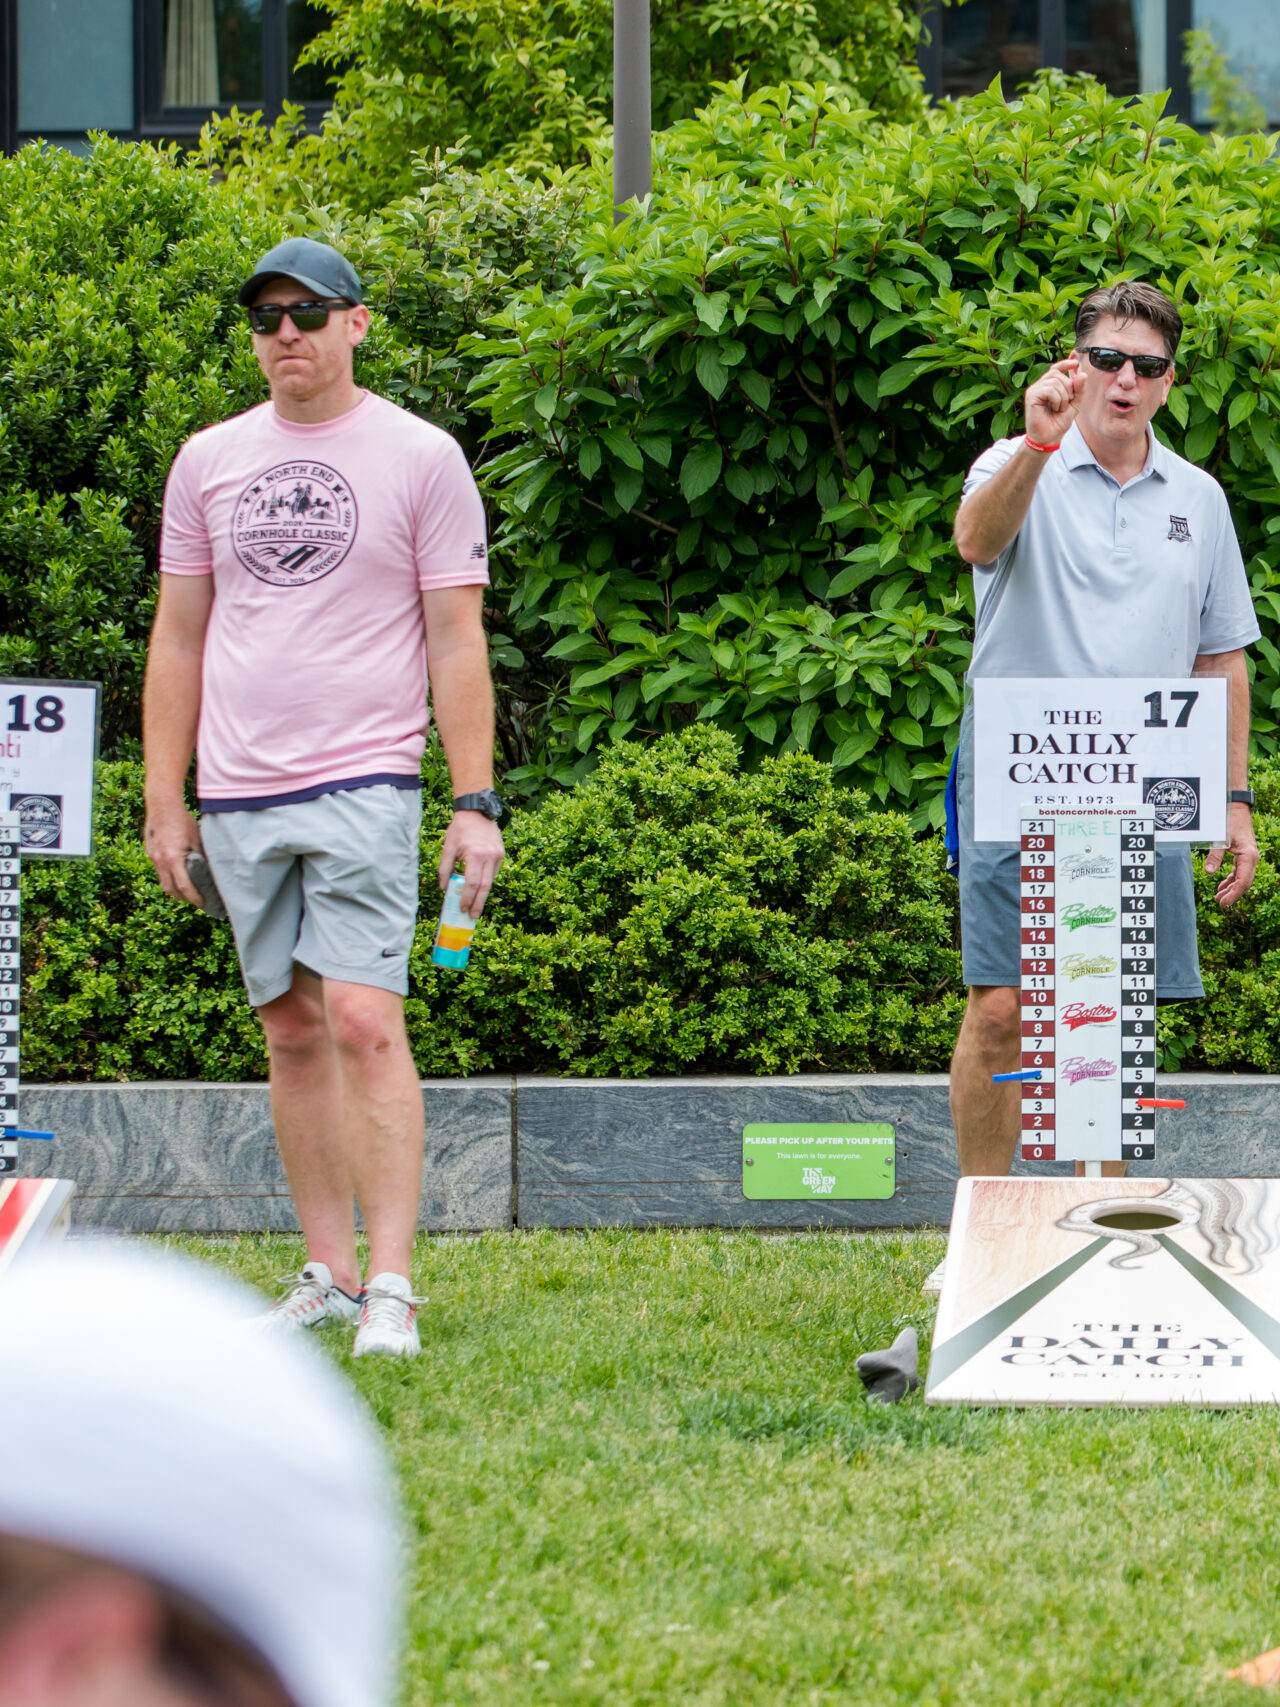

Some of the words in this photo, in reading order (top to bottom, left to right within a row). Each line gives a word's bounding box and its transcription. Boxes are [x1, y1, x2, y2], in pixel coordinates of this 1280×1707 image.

[265, 465, 309, 483] NORTH
[310, 466, 335, 482] END
[237, 528, 298, 543] CORNHOLE
[302, 528, 349, 543] CLASSIC
[7, 694, 65, 734] 18
[1143, 691, 1199, 728] 17
[1044, 710, 1102, 725] THE
[1008, 733, 1139, 755] DAILY
[1008, 762, 1139, 785] CATCH
[1034, 796, 1072, 804] EST.
[1078, 796, 1114, 804] 1973
[1039, 808, 1137, 816] bostoncornhole.com
[1028, 822, 1044, 832] 21
[1057, 820, 1117, 837] THREE
[1129, 822, 1144, 832] 21
[1028, 838, 1045, 848] 20
[1128, 838, 1146, 848] 20
[1030, 854, 1046, 863] 19
[1130, 854, 1146, 863] 19
[1028, 869, 1045, 879] 18
[1129, 869, 1146, 879] 18
[1030, 885, 1046, 894] 17
[1130, 885, 1146, 894] 17
[1028, 900, 1045, 910] 16
[1129, 900, 1146, 910] 16
[1030, 916, 1047, 925] 15
[1131, 916, 1147, 925] 15
[1029, 931, 1047, 941] 14
[1130, 931, 1147, 941] 14
[1030, 947, 1047, 956] 13
[1131, 947, 1147, 956] 13
[1030, 961, 1047, 972] 12
[1131, 961, 1147, 972] 12
[1030, 978, 1045, 987] 11
[1131, 978, 1146, 987] 11
[1030, 992, 1047, 1002] 10
[1131, 992, 1147, 1002] 10
[1034, 1008, 1042, 1018] 9
[1135, 1008, 1143, 1018] 9
[1034, 1023, 1042, 1034] 8
[1134, 1023, 1143, 1034] 8
[1034, 1040, 1042, 1049] 7
[1134, 1040, 1143, 1049] 7
[1034, 1054, 1043, 1065] 6
[1134, 1054, 1143, 1065] 6
[1135, 1070, 1143, 1080] 5
[1034, 1086, 1043, 1096] 4
[1134, 1086, 1143, 1096] 4
[1034, 1101, 1042, 1111] 3
[1034, 1116, 1042, 1126] 2
[1134, 1116, 1143, 1126] 2
[745, 1137, 778, 1145] PLEASE
[779, 1137, 800, 1145] PICK
[802, 1137, 814, 1145] UP
[815, 1137, 844, 1145] AFTER
[845, 1137, 870, 1145] YOUR
[872, 1137, 893, 1145] PETS
[1035, 1132, 1041, 1142] 1
[1136, 1132, 1142, 1142] 1
[1034, 1147, 1042, 1158] 0
[1134, 1147, 1143, 1158] 0
[802, 1168, 823, 1177] THE
[802, 1176, 836, 1185] GREEN
[1072, 1323, 1182, 1333] THE
[1008, 1336, 1246, 1350] DAILY
[1001, 1352, 1248, 1367] CATCH
